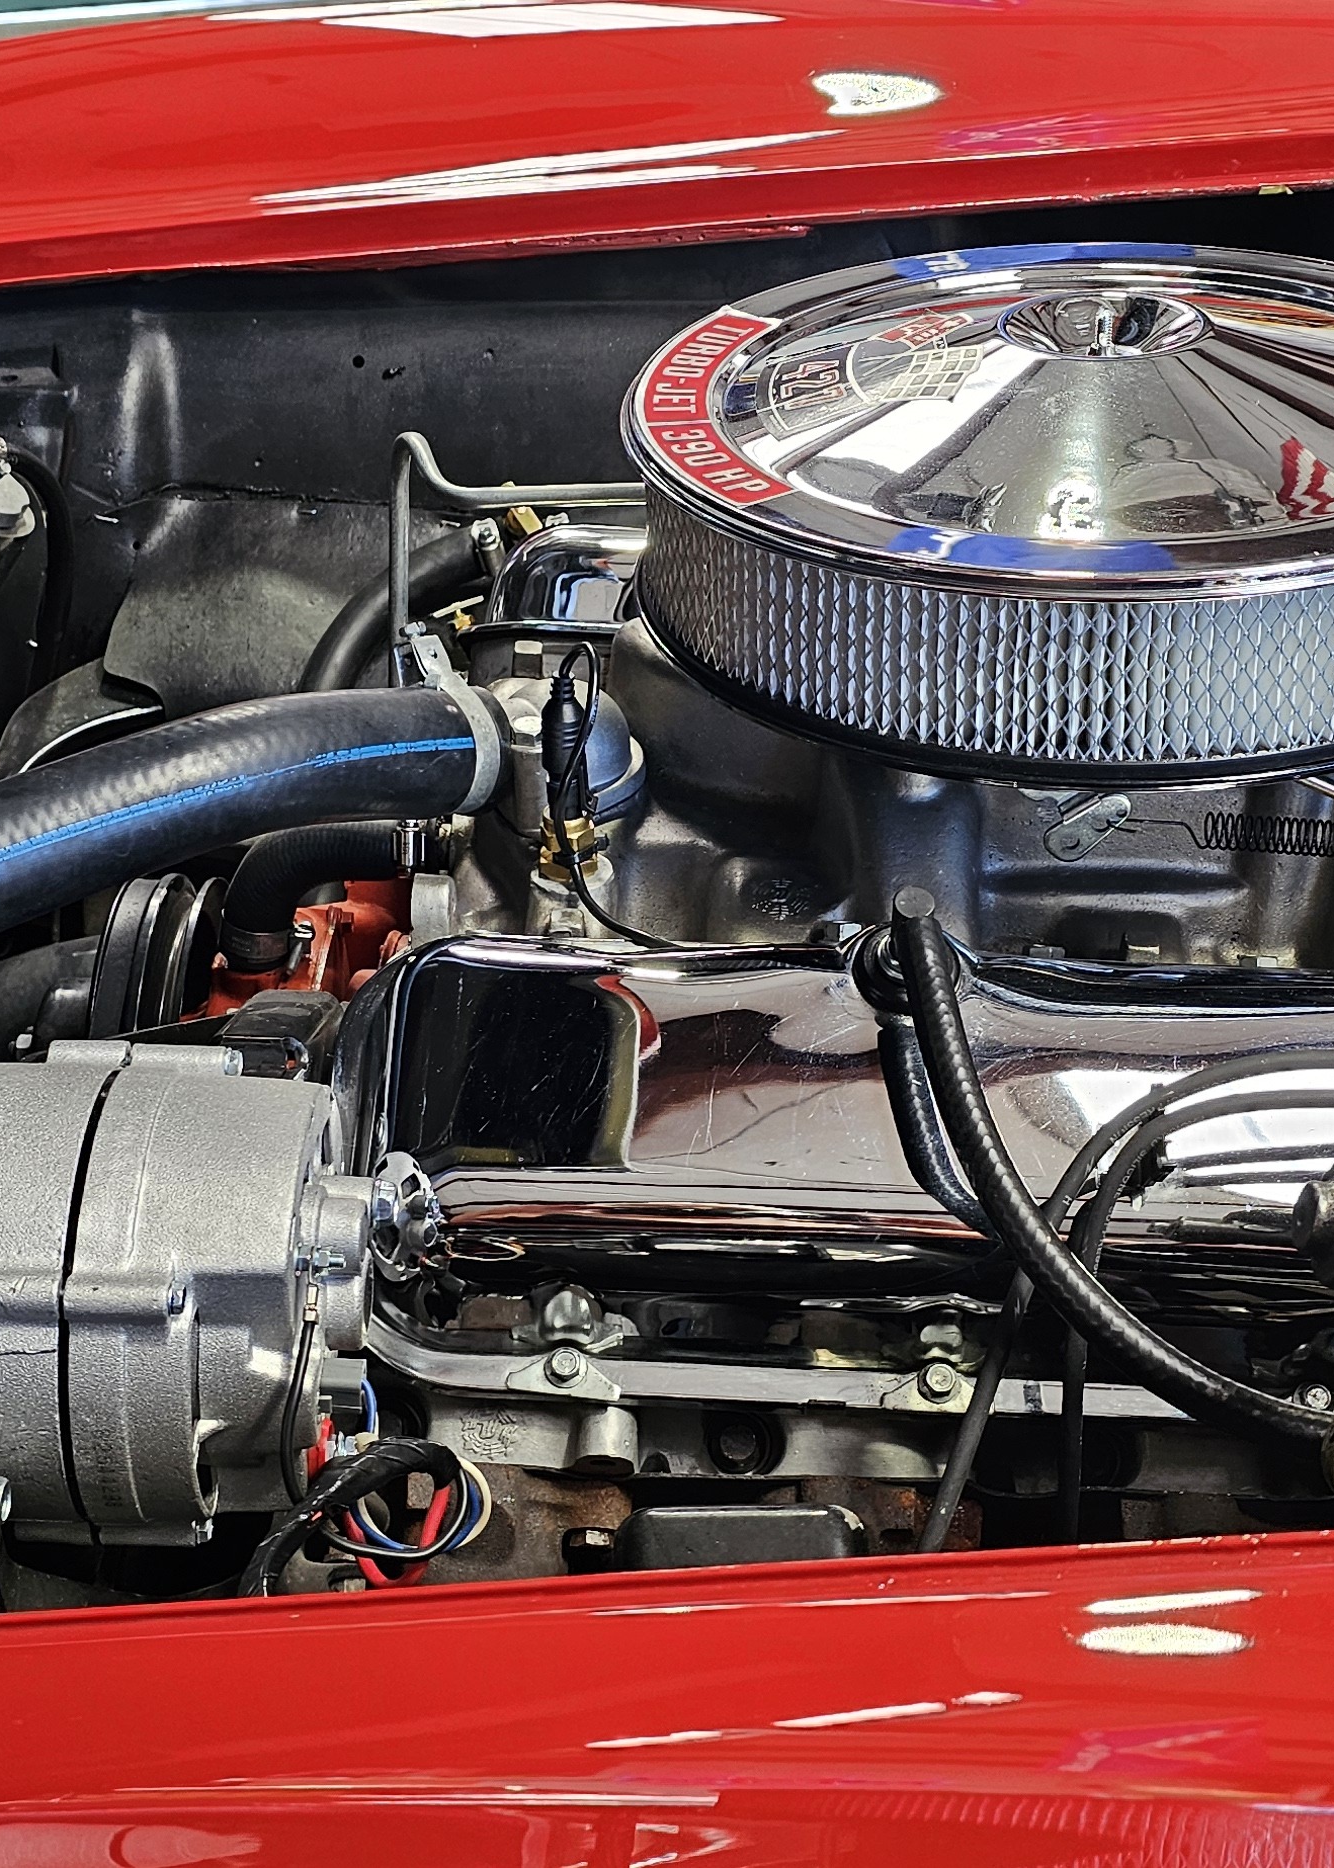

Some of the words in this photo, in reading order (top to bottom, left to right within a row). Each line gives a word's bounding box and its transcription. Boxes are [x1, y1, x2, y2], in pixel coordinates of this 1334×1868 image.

[654, 324, 754, 414] TURBO-JET
[780, 359, 845, 411] 427
[663, 430, 730, 467] 390
[703, 466, 771, 494] HP
